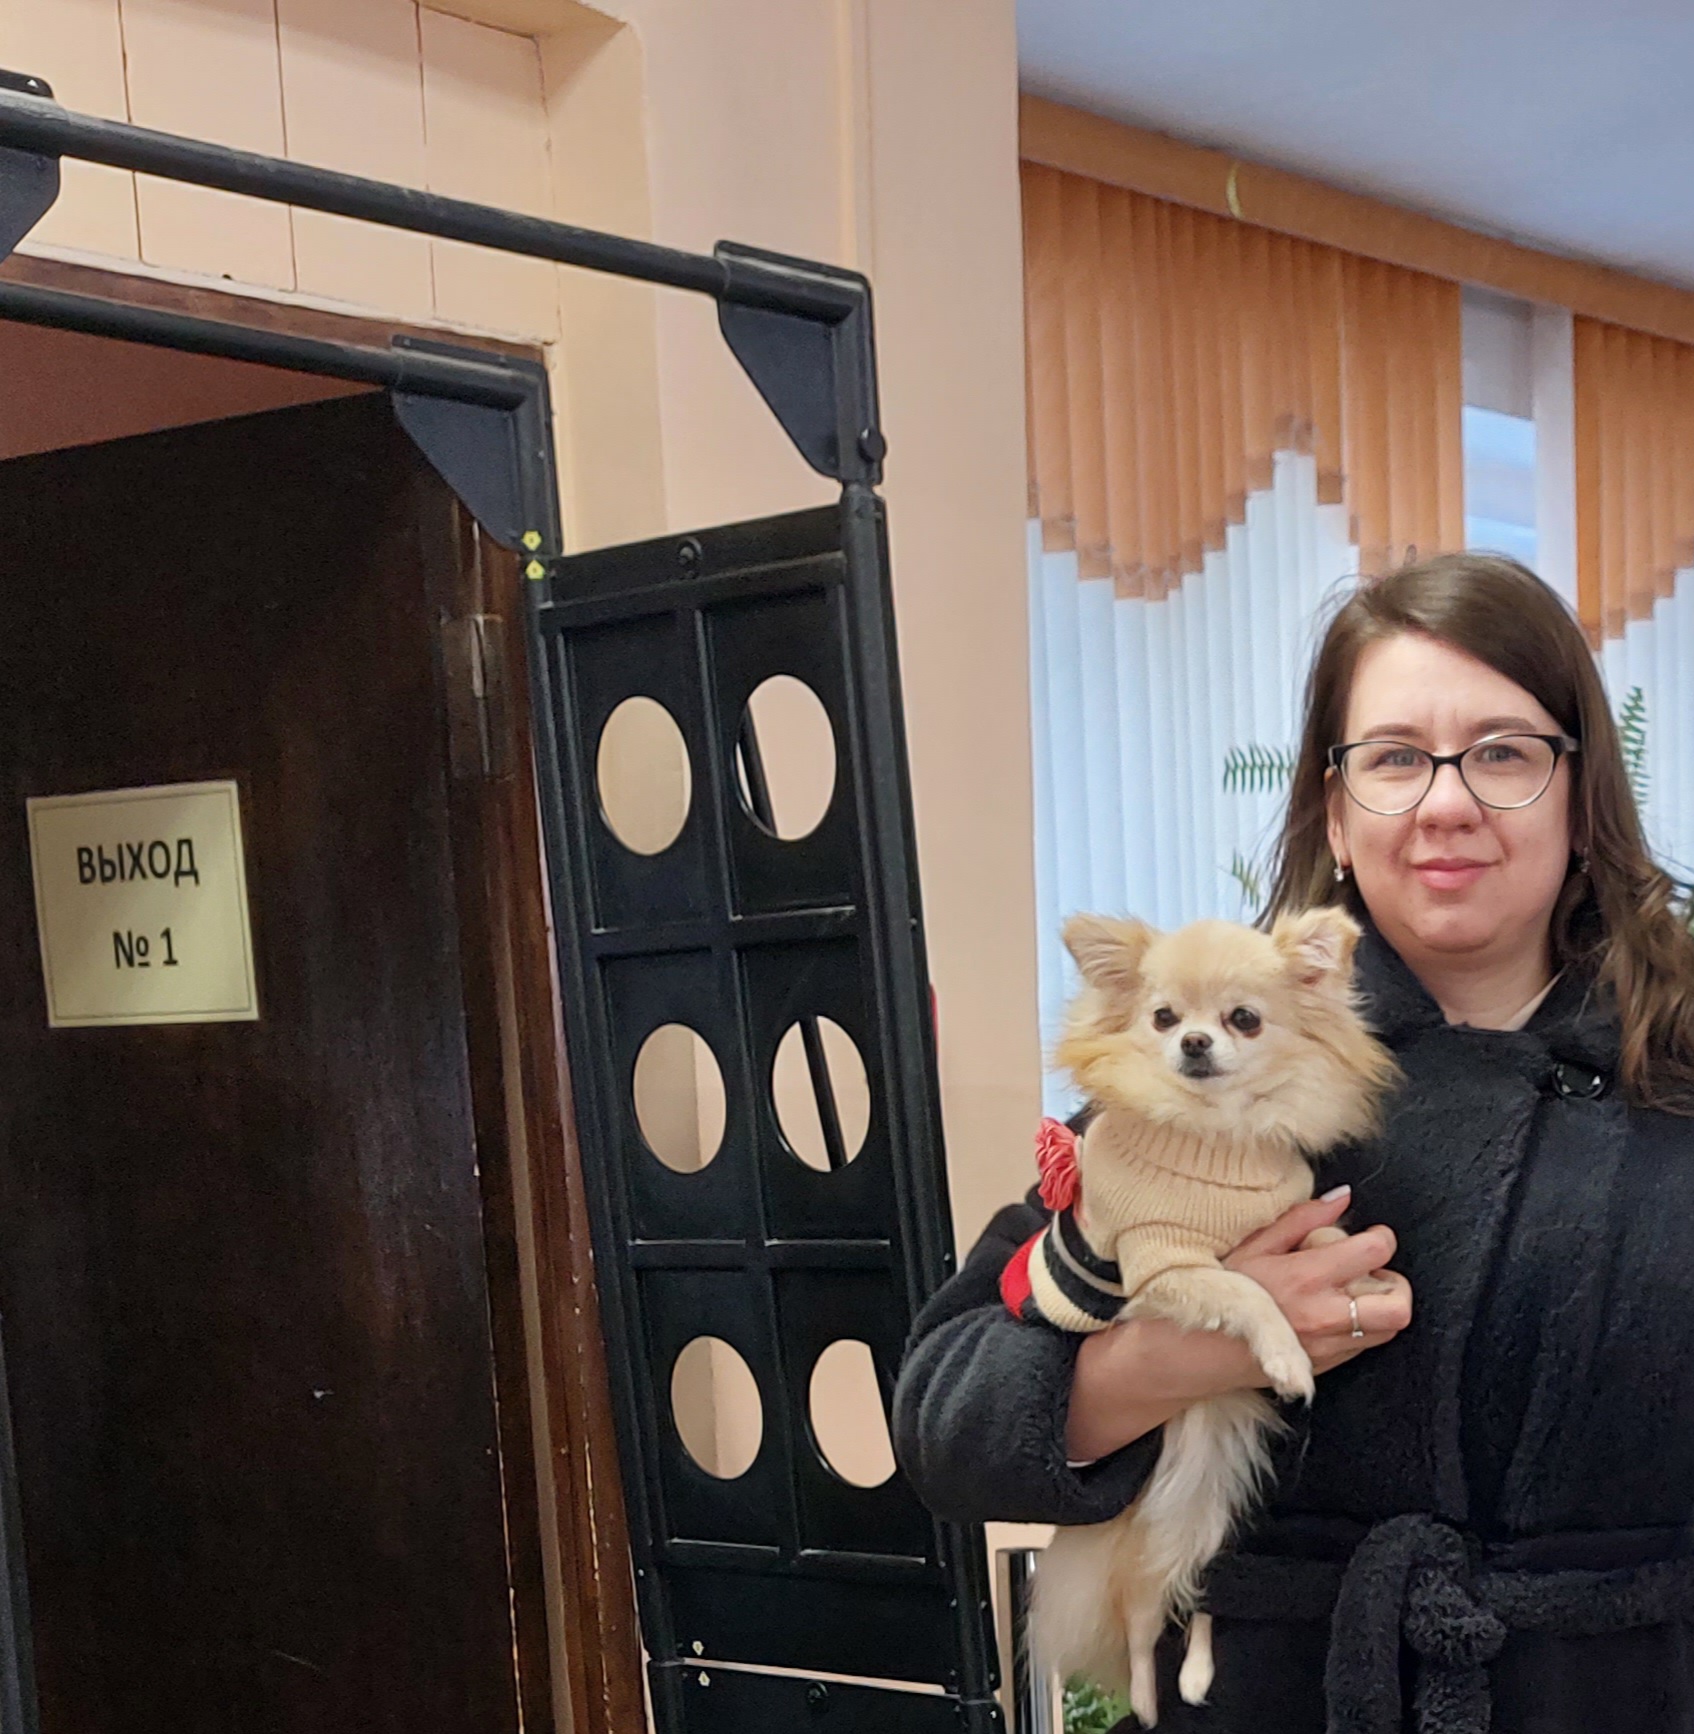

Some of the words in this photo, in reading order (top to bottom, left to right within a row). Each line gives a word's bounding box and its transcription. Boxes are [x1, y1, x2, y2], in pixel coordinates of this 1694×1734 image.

[77, 838, 200, 886] ВЫХОД
[112, 929, 151, 969] №
[160, 926, 178, 966] 1
